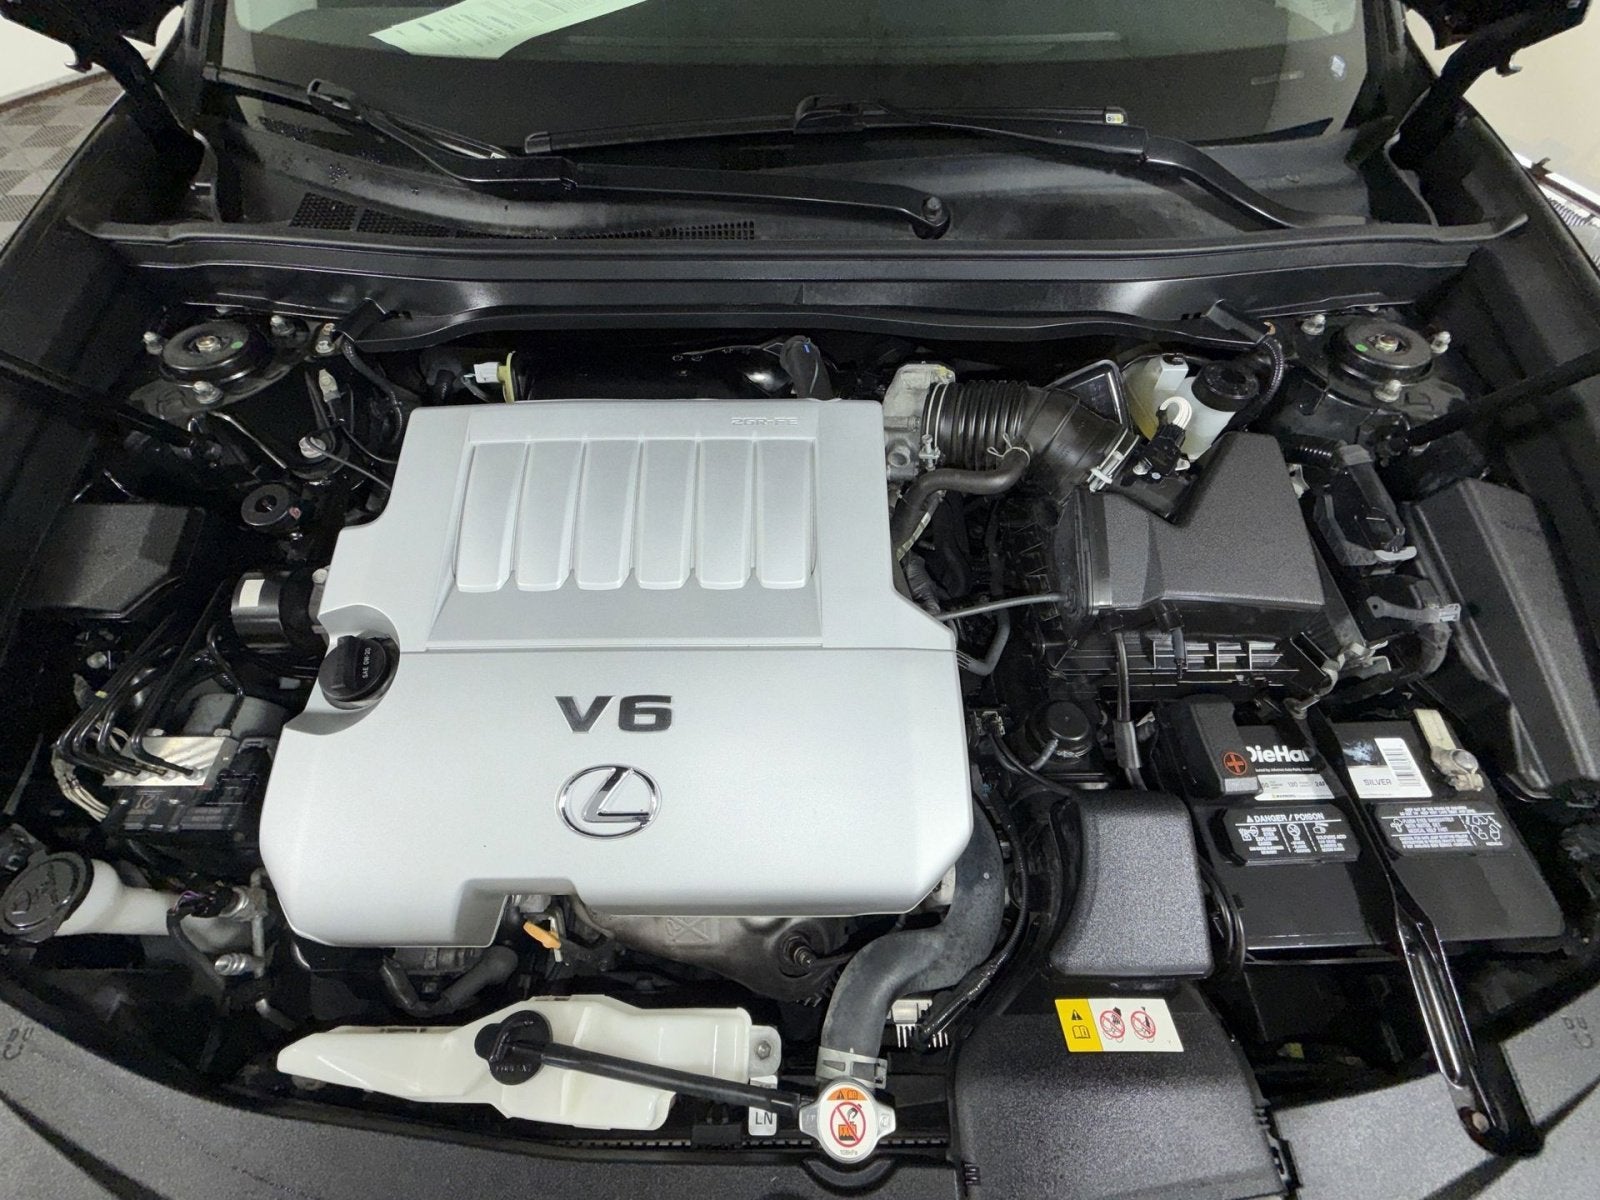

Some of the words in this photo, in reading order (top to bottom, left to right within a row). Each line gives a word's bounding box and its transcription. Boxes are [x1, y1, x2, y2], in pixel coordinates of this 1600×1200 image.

[554, 694, 673, 733] V6
[1363, 778, 1392, 786] SILVER
[1253, 814, 1288, 823] DANGER
[1294, 812, 1325, 821] POISON
[755, 1111, 773, 1125] LN
